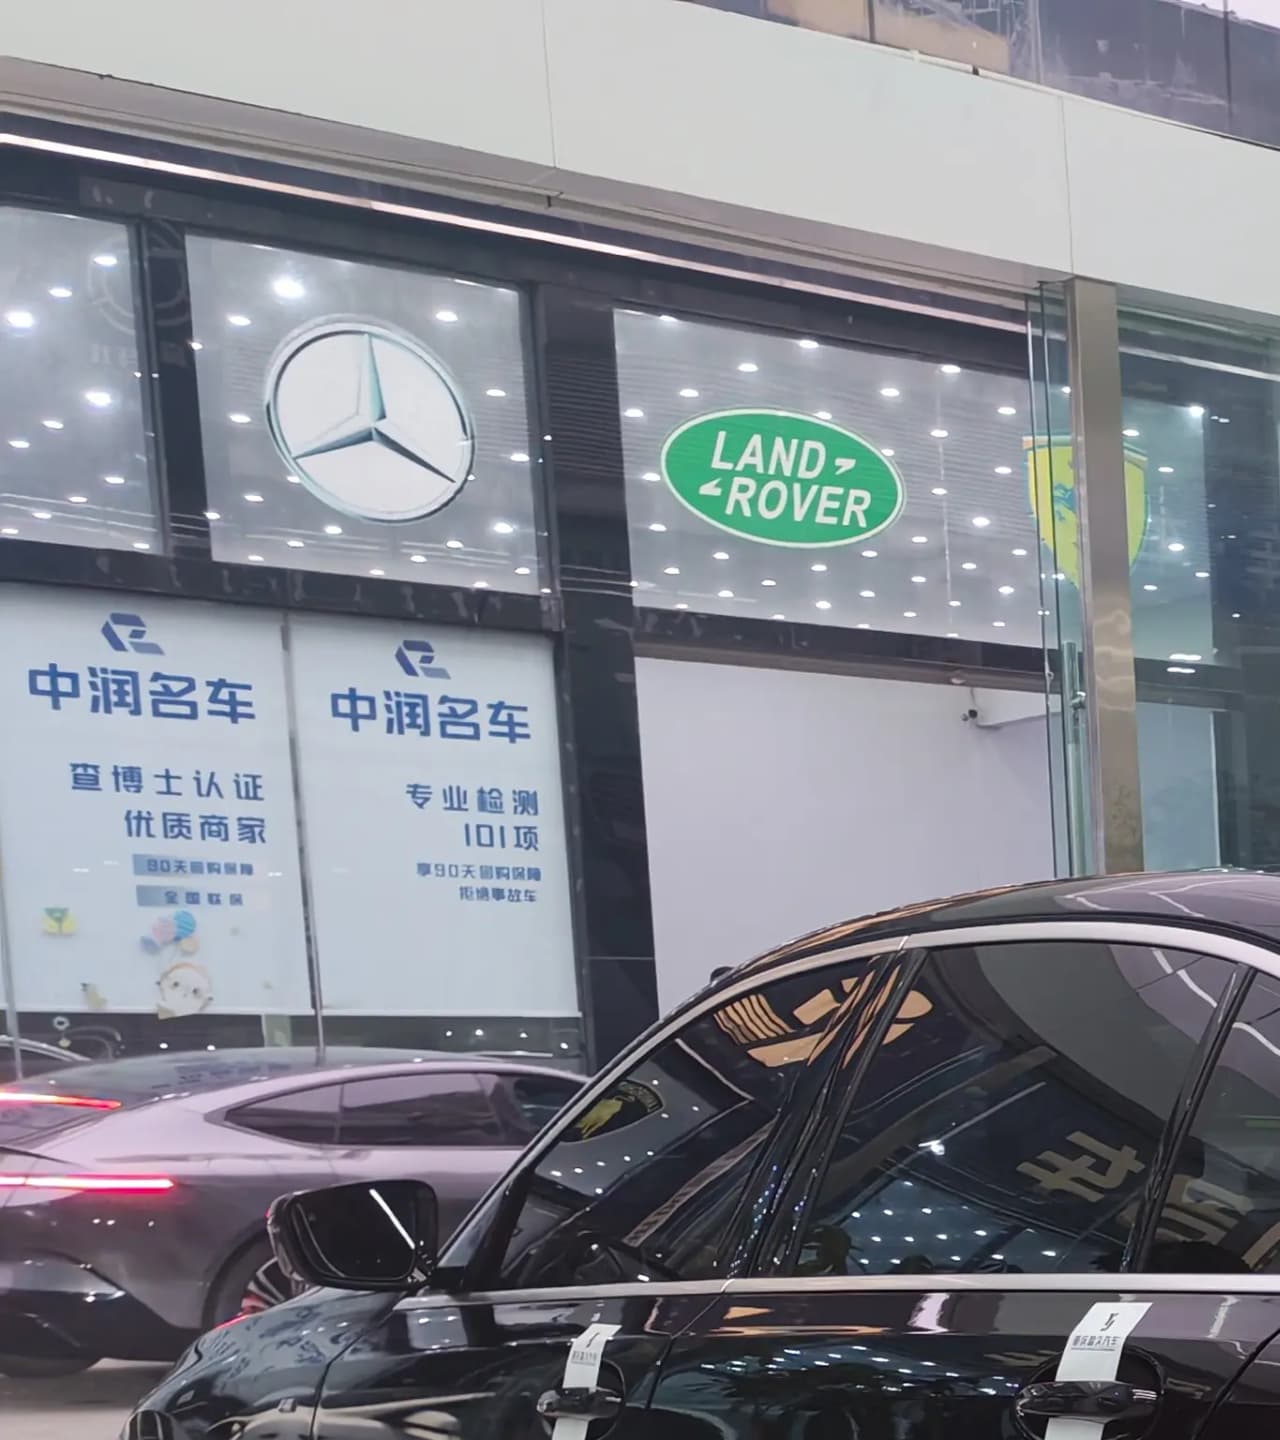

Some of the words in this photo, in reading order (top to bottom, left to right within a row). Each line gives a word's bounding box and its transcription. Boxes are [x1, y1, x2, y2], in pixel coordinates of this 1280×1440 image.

[711, 430, 827, 480] LAND
[724, 475, 872, 528] ROVER
[28, 662, 256, 724] 中润名车
[330, 687, 531, 744] 中润名车
[69, 761, 265, 802] 查博士认证
[405, 783, 539, 817] 专业检测
[124, 809, 267, 844] 优质商家
[464, 823, 539, 852] 101项
